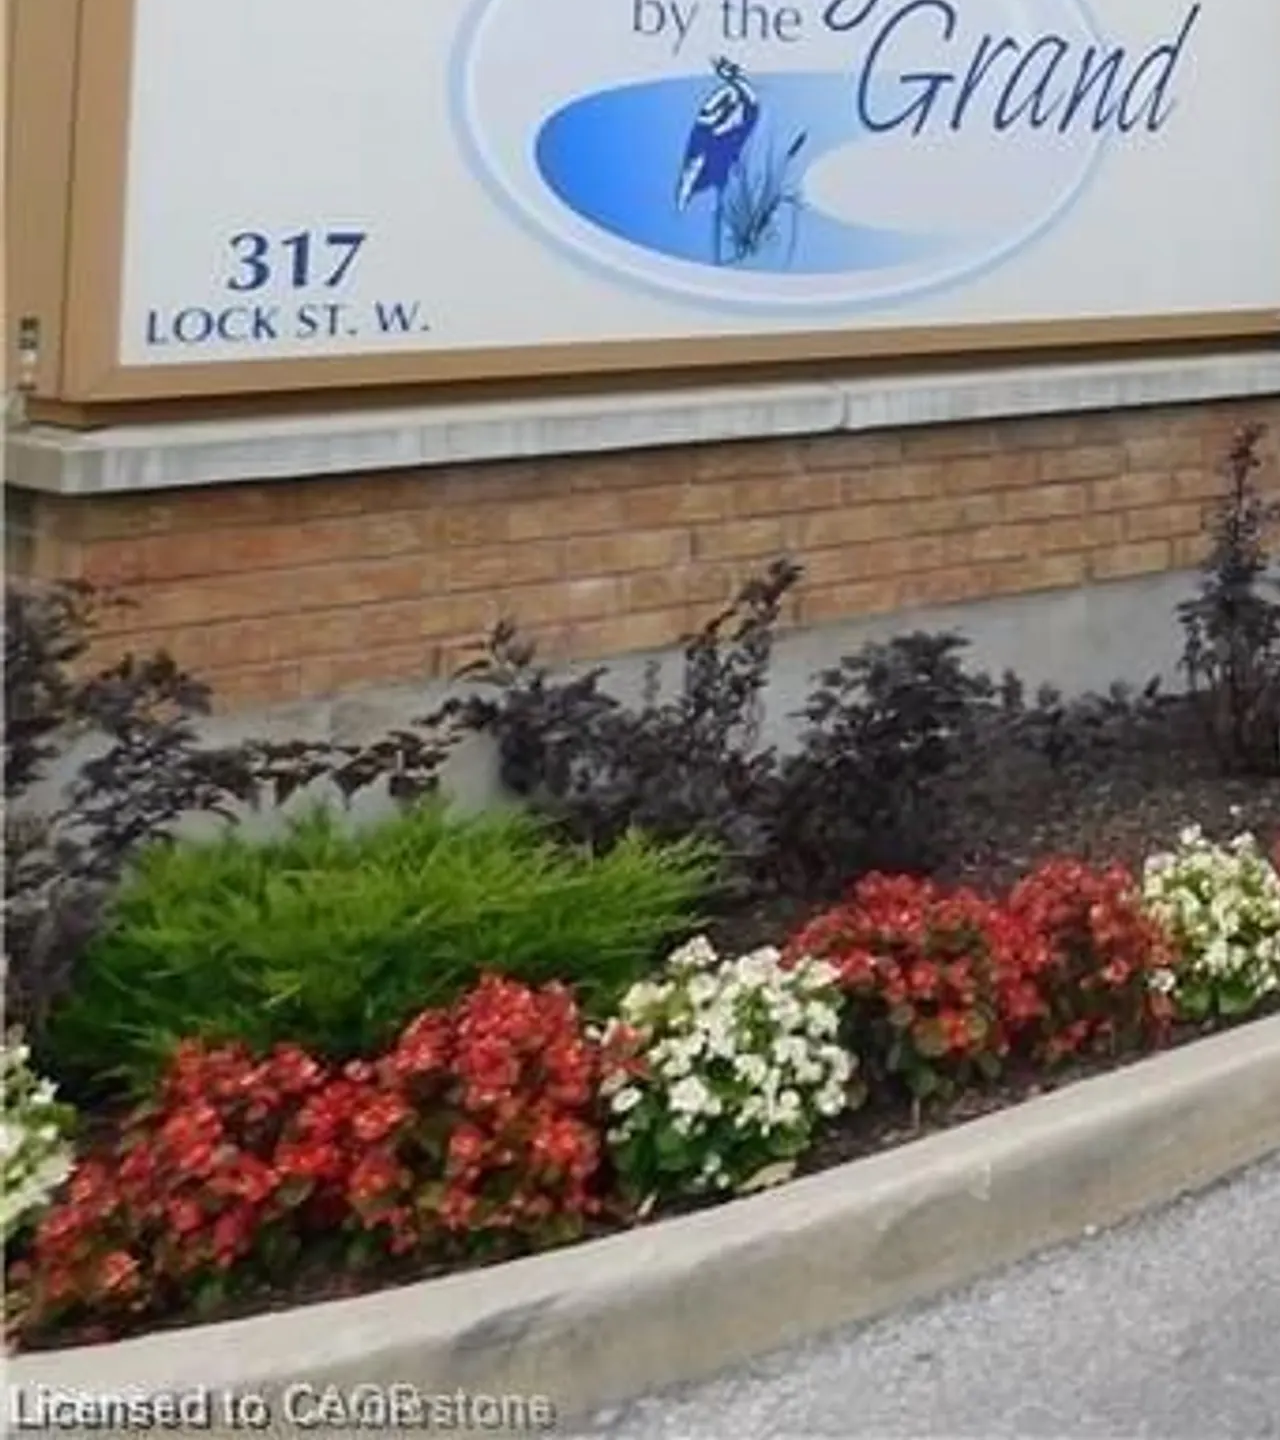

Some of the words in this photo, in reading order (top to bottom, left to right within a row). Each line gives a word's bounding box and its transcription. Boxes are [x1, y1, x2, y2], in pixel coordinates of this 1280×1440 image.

[226, 231, 367, 292] 317
[146, 305, 278, 346] LOCK
[296, 303, 359, 339] ST.
[374, 300, 431, 334] W.
